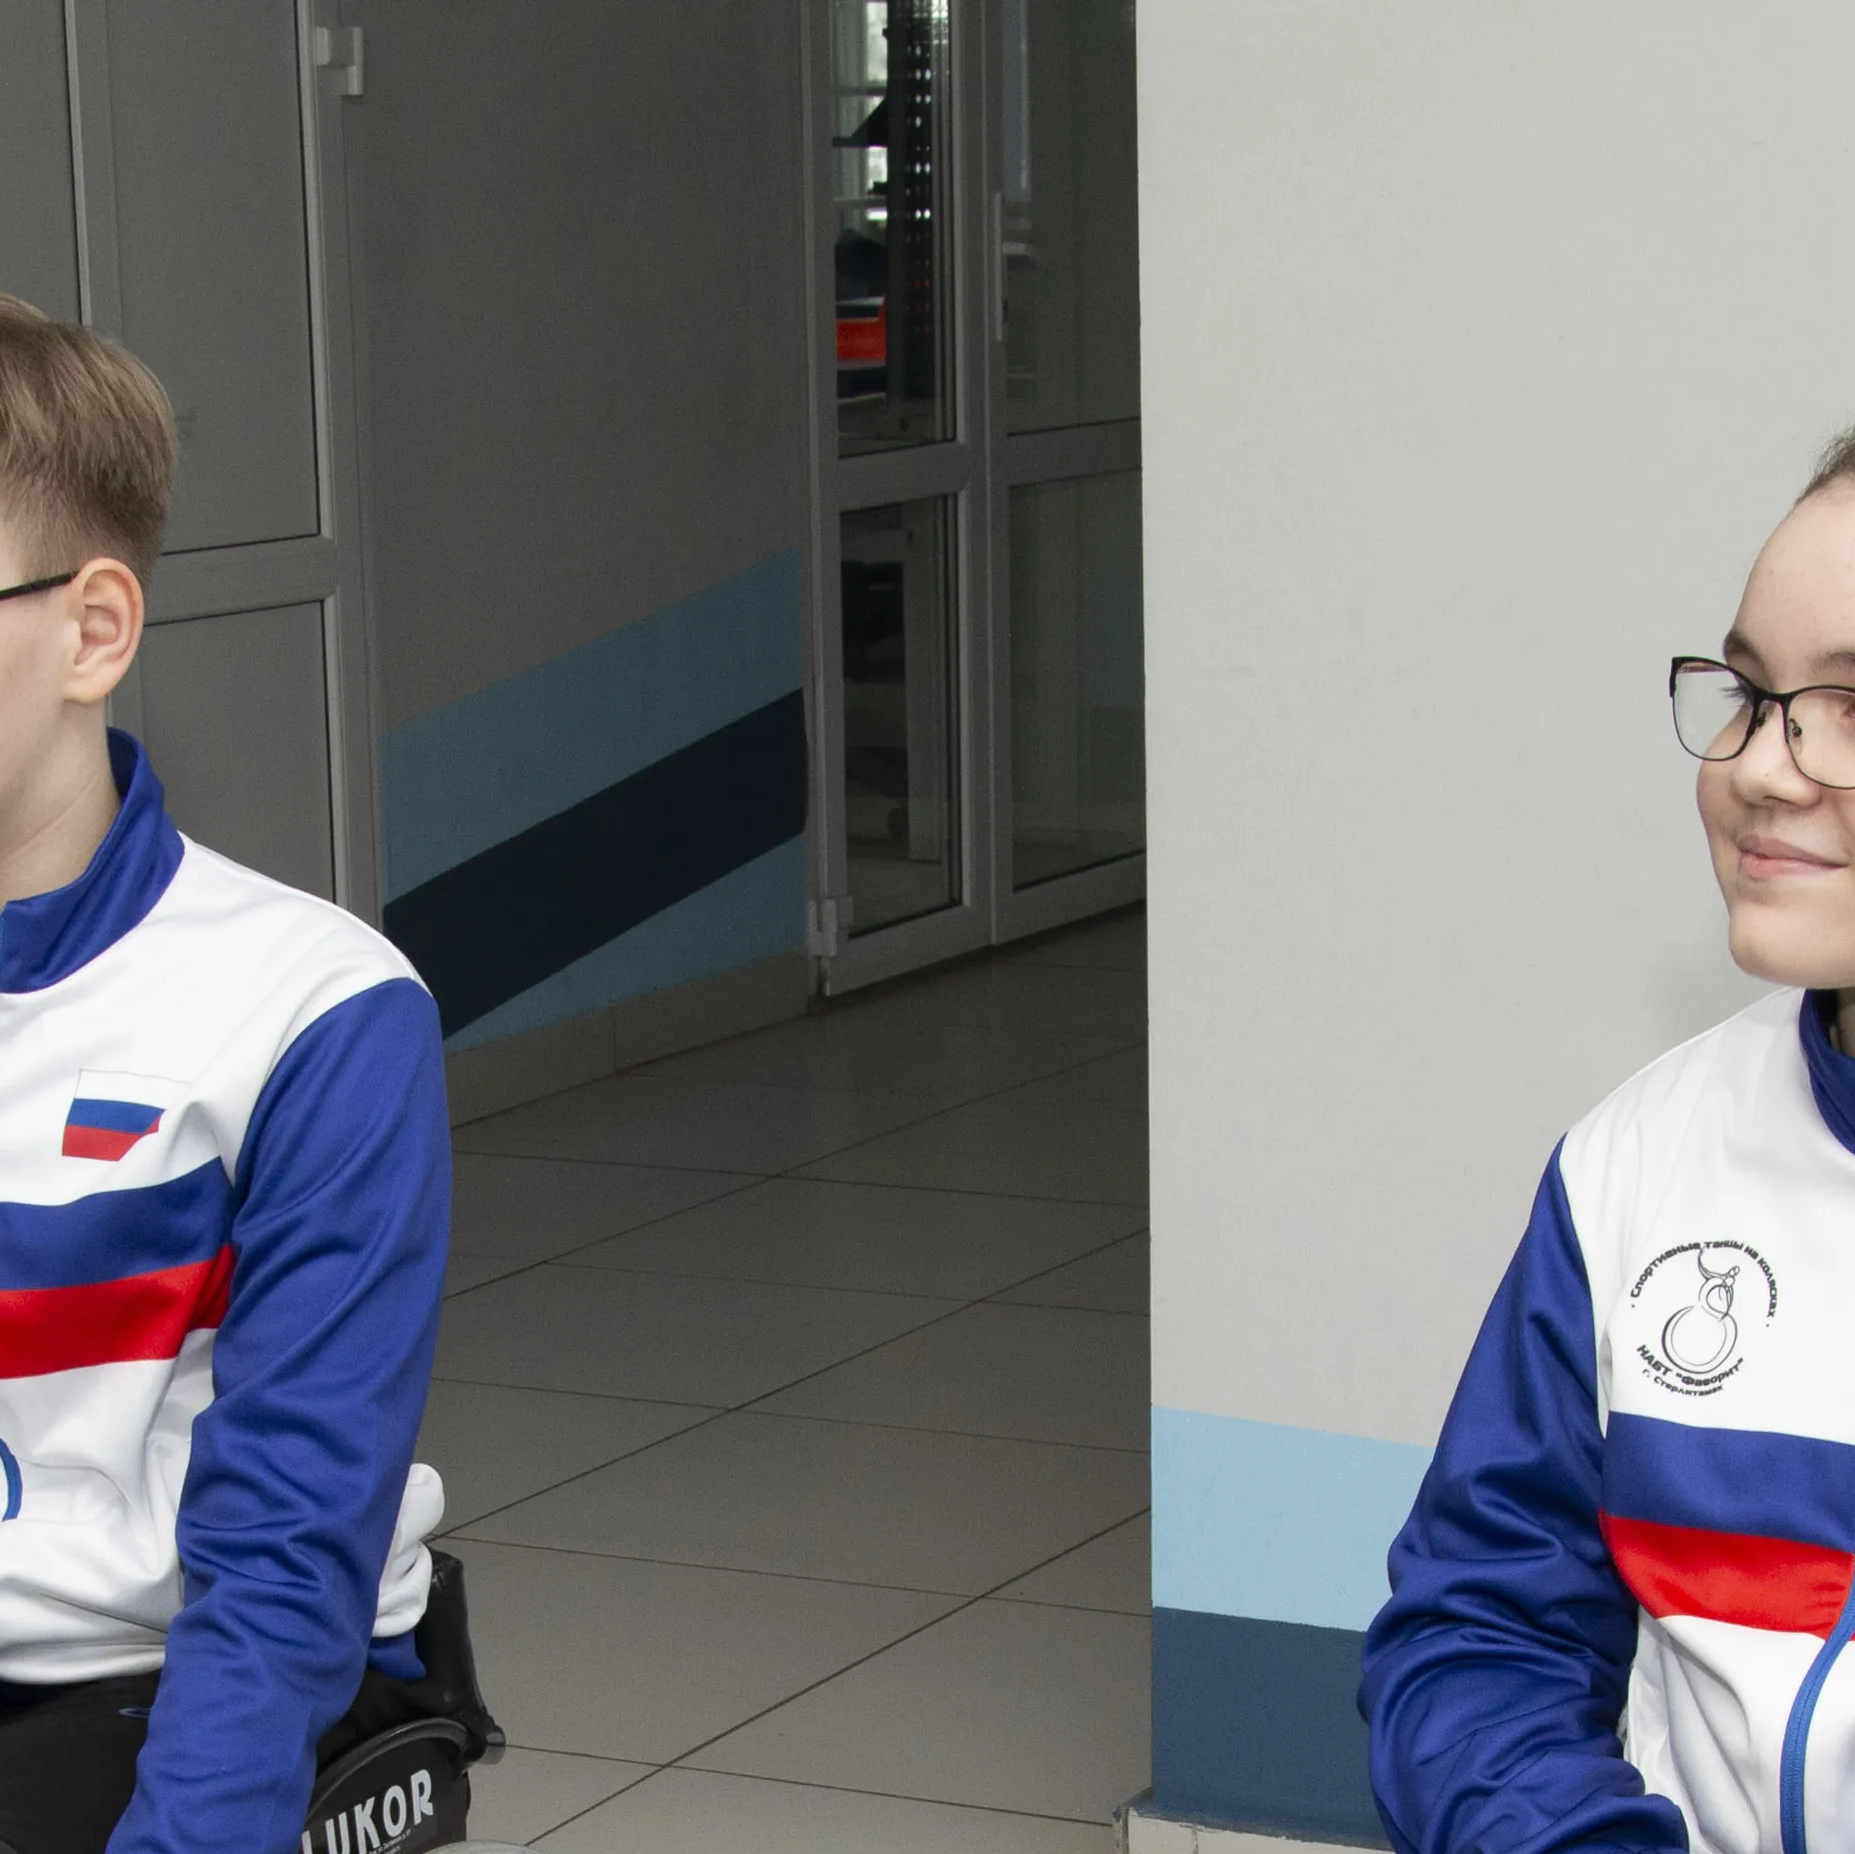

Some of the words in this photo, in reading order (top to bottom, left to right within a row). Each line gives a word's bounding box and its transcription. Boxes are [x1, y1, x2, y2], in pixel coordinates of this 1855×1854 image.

[1630, 1242, 1701, 1298] Спортивные
[1704, 1239, 1745, 1250] танцы
[1744, 1244, 1759, 1260] на
[1757, 1258, 1778, 1318] колясках
[1636, 1344, 1673, 1376] НАБТ
[1675, 1357, 1744, 1387] "Фаворит"
[1653, 1375, 1724, 1396] Стерлитамак
